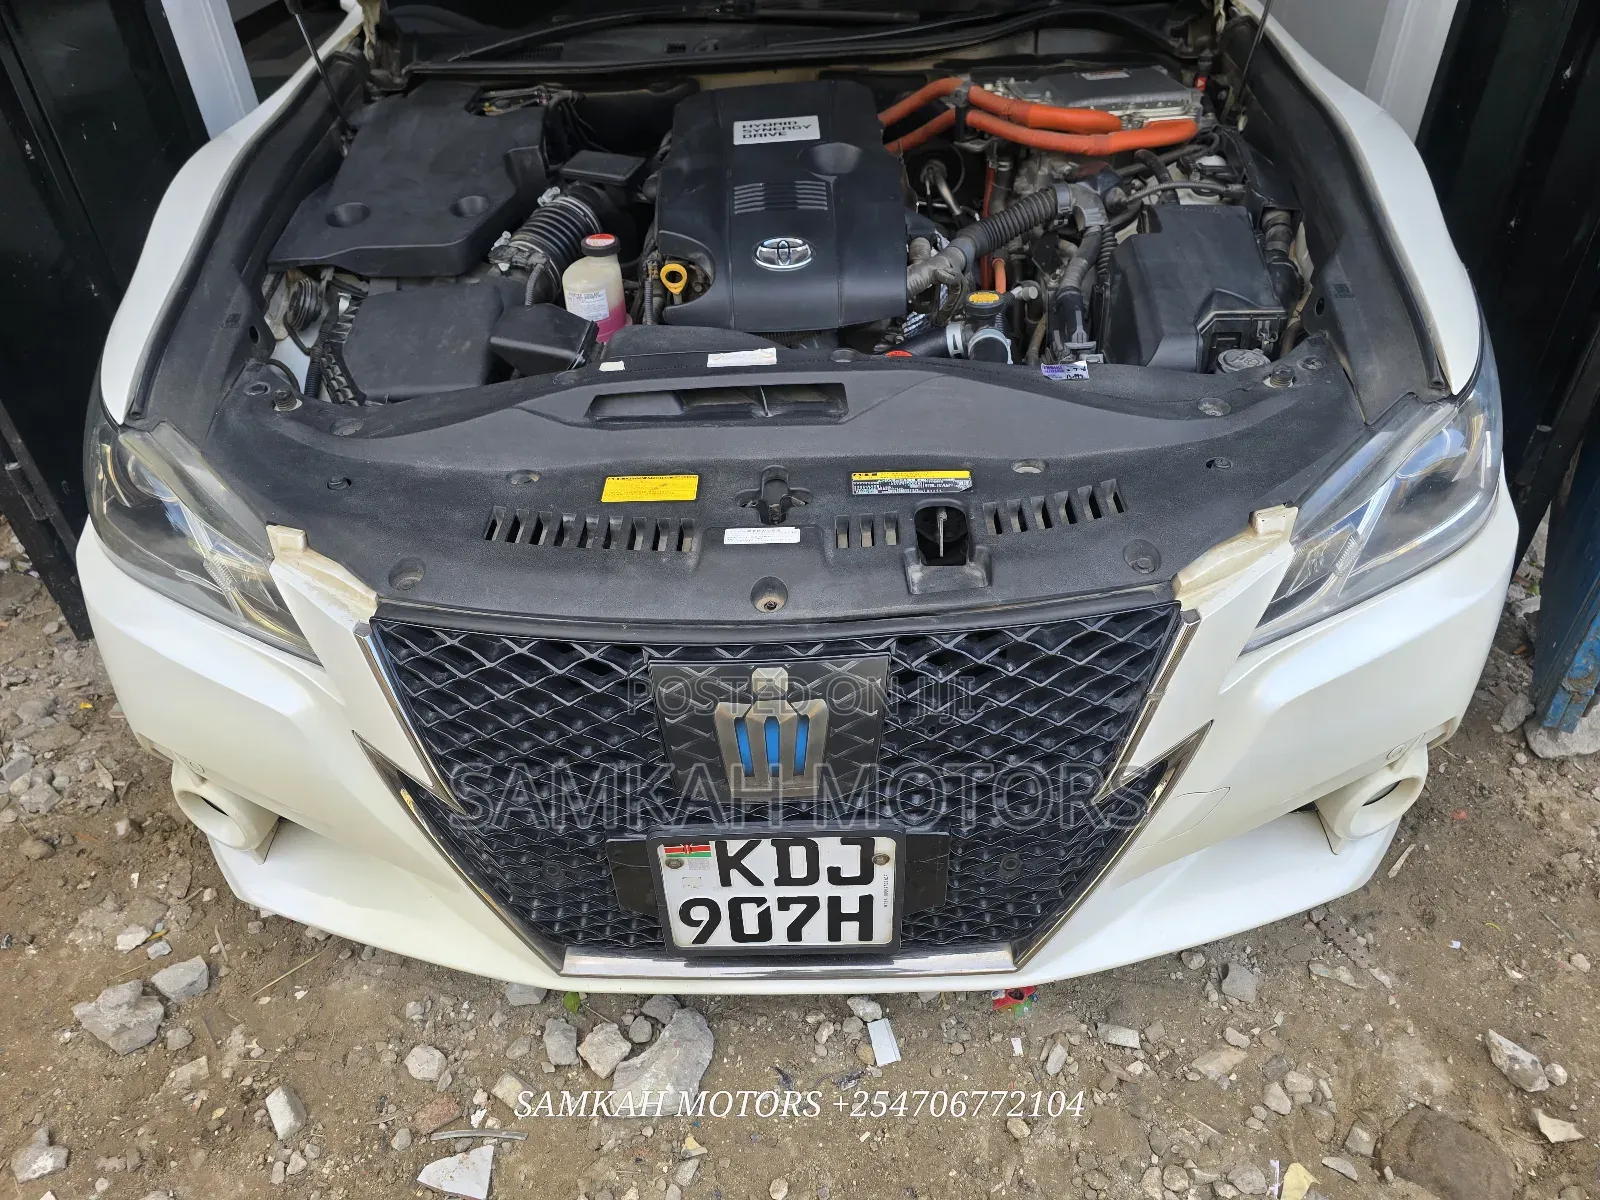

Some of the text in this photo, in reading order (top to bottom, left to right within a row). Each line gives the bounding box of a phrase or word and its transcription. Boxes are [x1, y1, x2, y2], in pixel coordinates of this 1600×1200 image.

[742, 121, 798, 129] HYBRID
[742, 124, 812, 133] SYNERGY
[714, 837, 876, 887] KDJ
[678, 893, 874, 944] 907H
